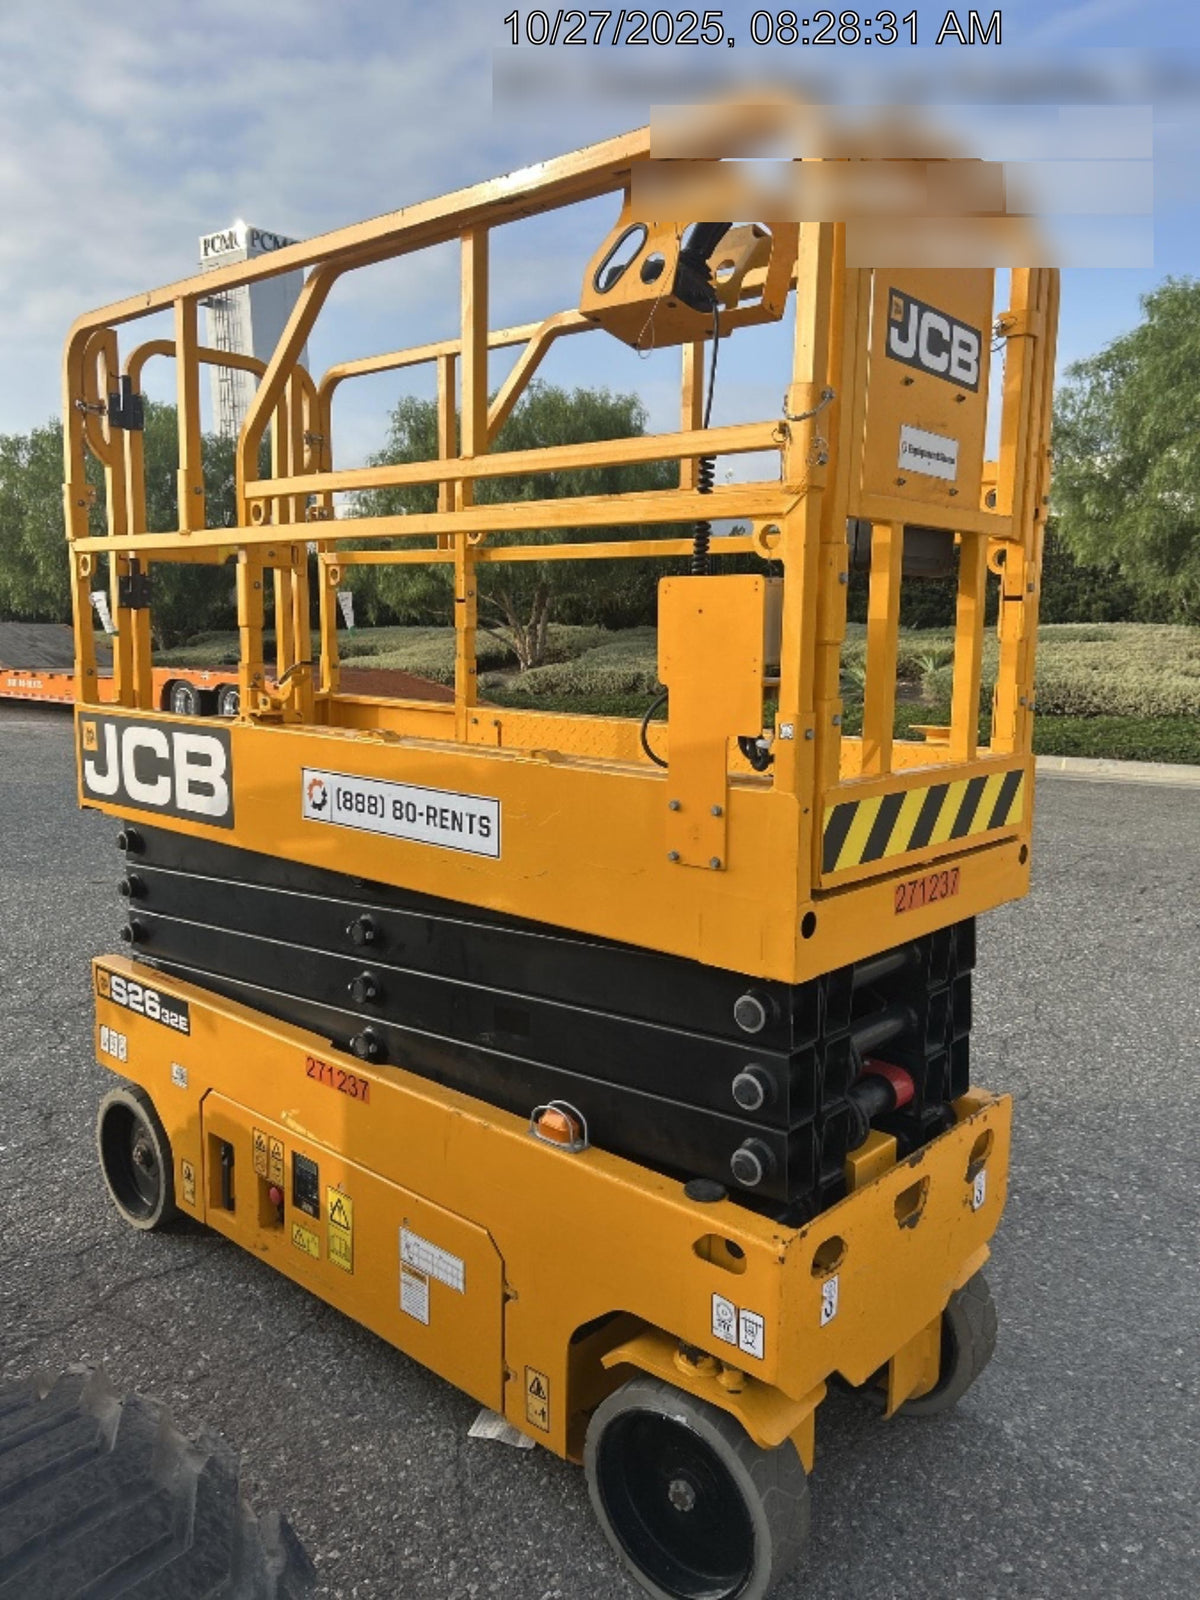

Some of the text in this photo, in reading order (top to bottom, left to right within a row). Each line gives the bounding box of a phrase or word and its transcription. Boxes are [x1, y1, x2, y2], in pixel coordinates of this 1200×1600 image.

[890, 303, 979, 385] JCB
[84, 722, 228, 817] JCB
[336, 786, 492, 839] (888) 80-RENTS
[894, 866, 959, 914] 271237
[307, 1056, 369, 1101] 271237
